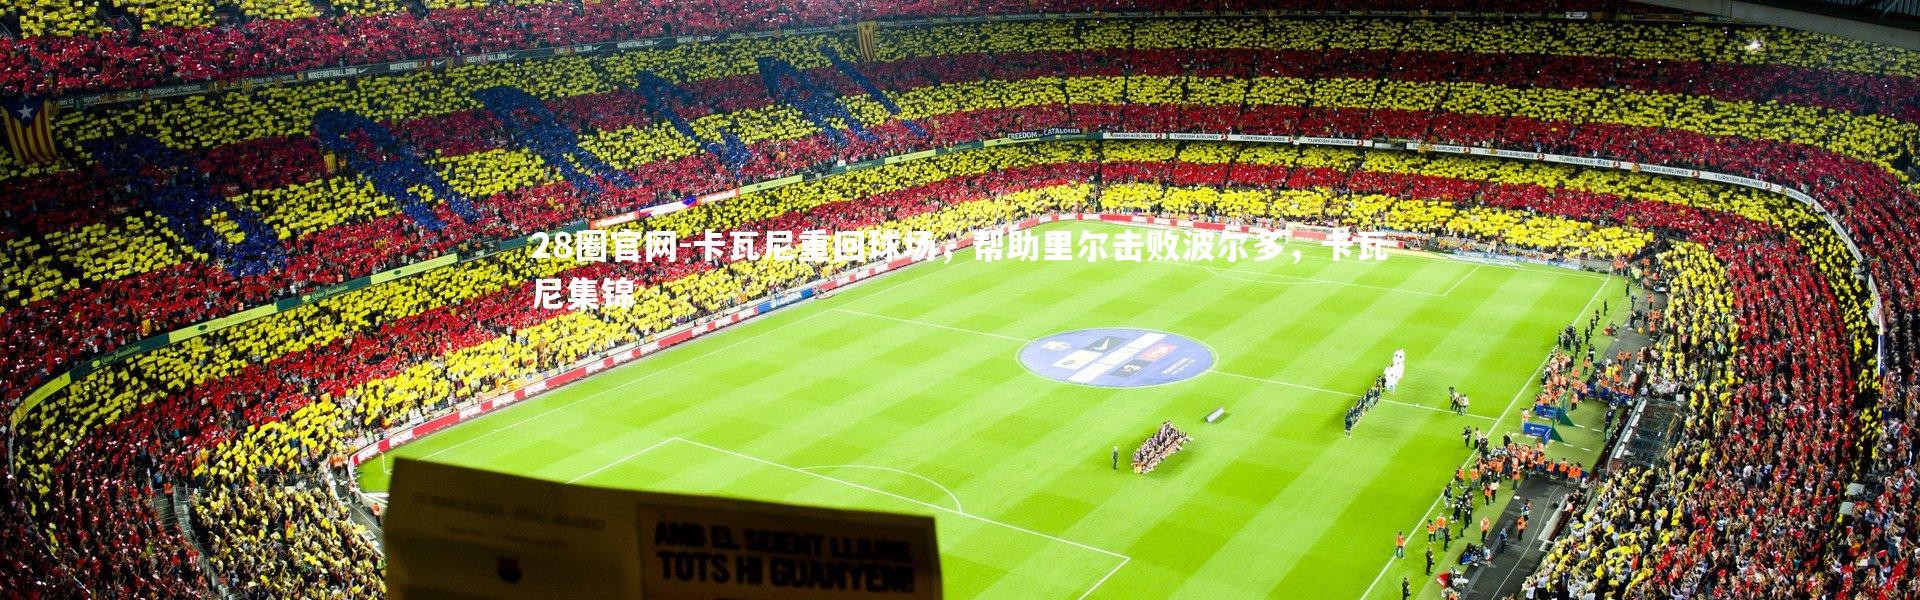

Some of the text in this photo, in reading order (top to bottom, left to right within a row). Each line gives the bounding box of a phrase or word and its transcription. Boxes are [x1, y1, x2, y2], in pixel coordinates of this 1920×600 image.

[307, 67, 357, 79] NIKEFOOTBALL.COM
[1007, 131, 1038, 140] FREEDOM
[1043, 128, 1080, 136] CATALONIA
[1662, 167, 1688, 176] AIRLINES
[655, 521, 706, 547] AMB
[710, 524, 738, 550] EL
[657, 550, 730, 583] TOTS
[735, 554, 763, 586] HI
